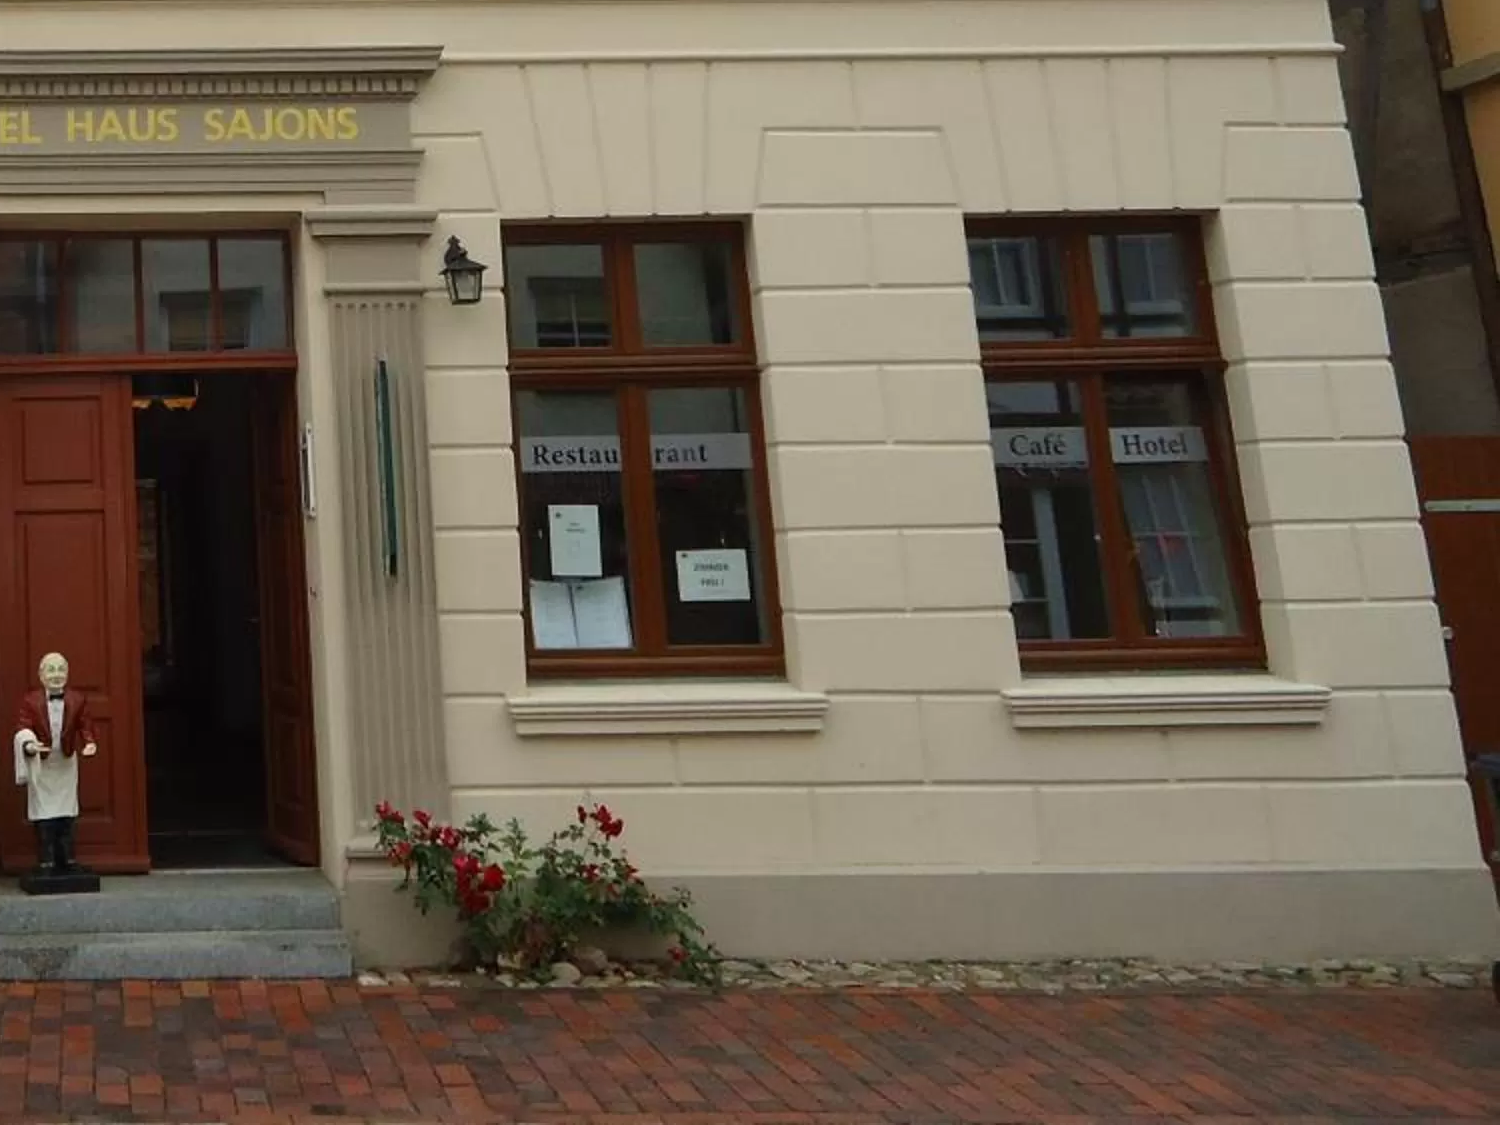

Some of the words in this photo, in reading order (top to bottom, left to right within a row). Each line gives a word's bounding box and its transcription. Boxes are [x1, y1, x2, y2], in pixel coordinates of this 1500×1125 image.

[66, 106, 180, 143] HAUS
[203, 105, 360, 142] SAJONS
[1008, 433, 1067, 456] Café
[1121, 432, 1189, 456] Hotel
